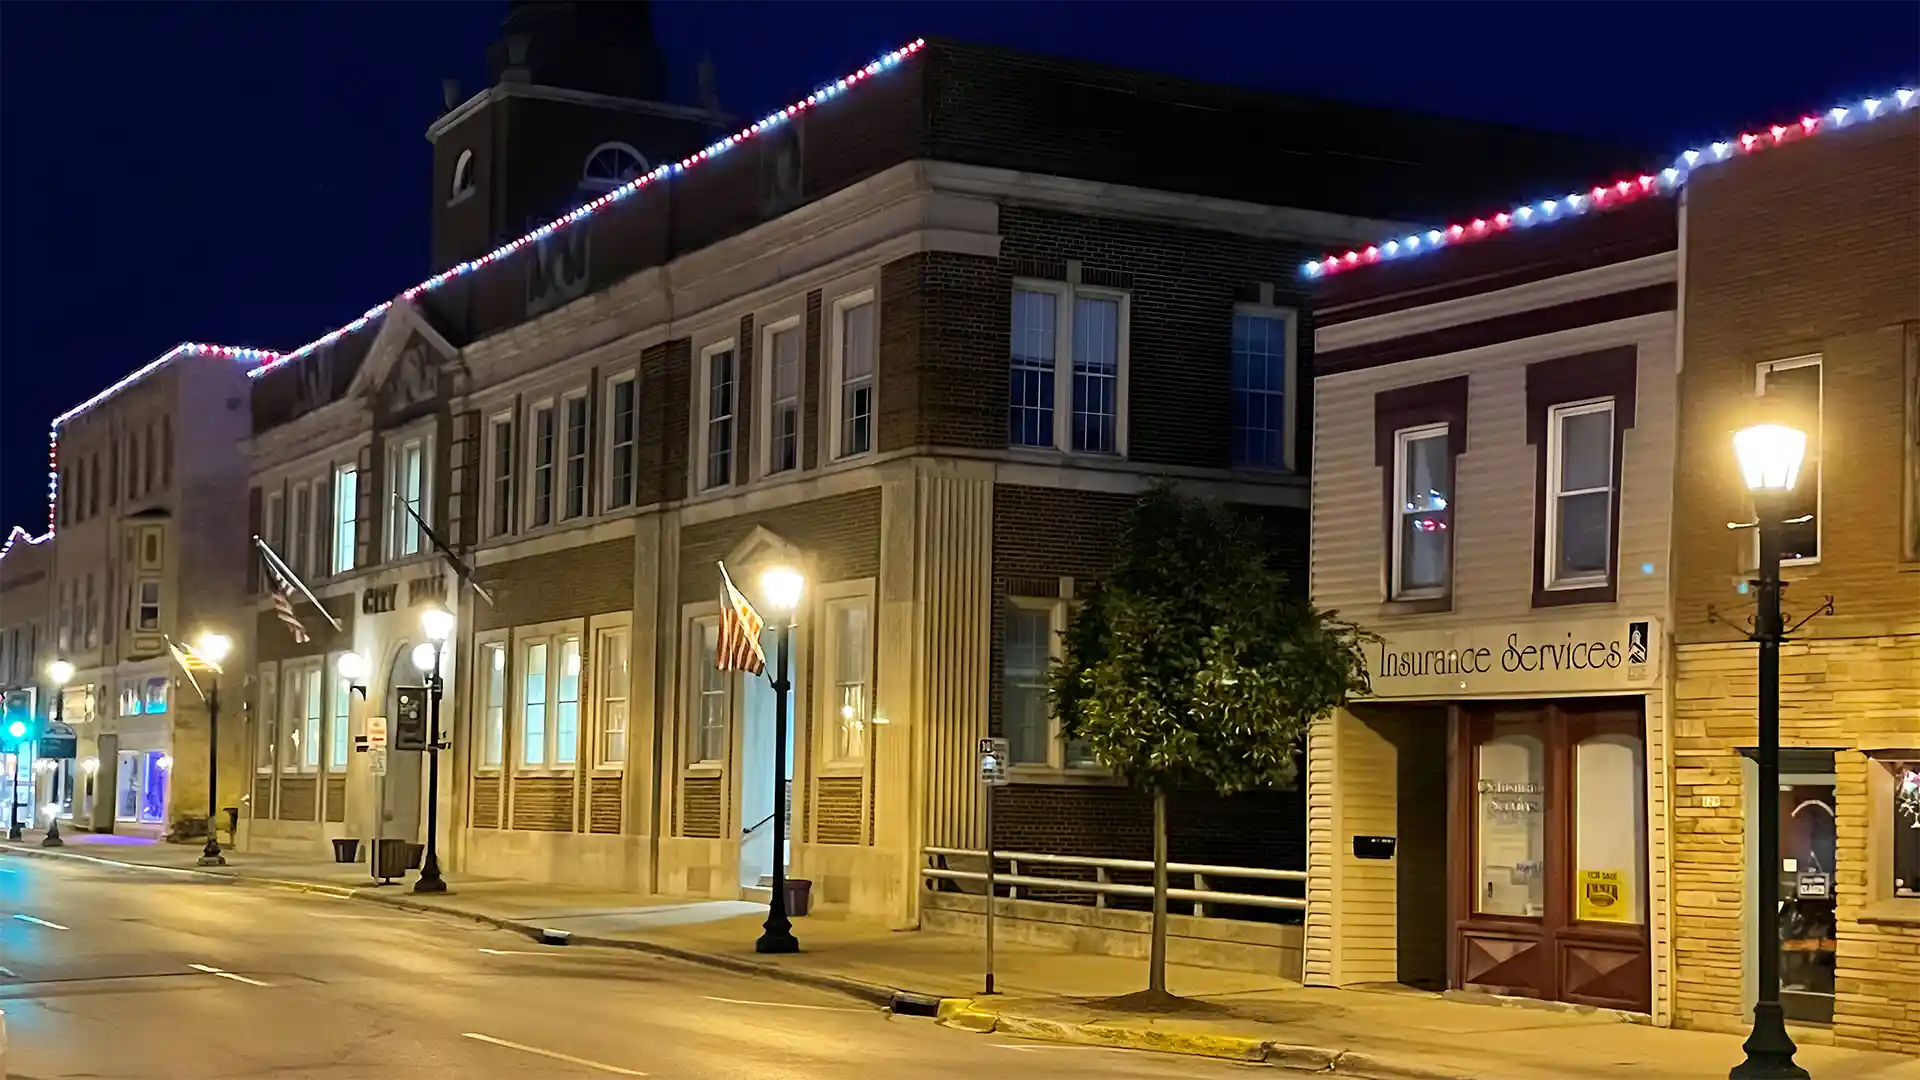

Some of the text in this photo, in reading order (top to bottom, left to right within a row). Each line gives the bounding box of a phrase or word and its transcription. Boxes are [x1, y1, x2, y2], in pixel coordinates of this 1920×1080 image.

[363, 583, 398, 614] CITY
[1380, 632, 1622, 677] Insurance Services
